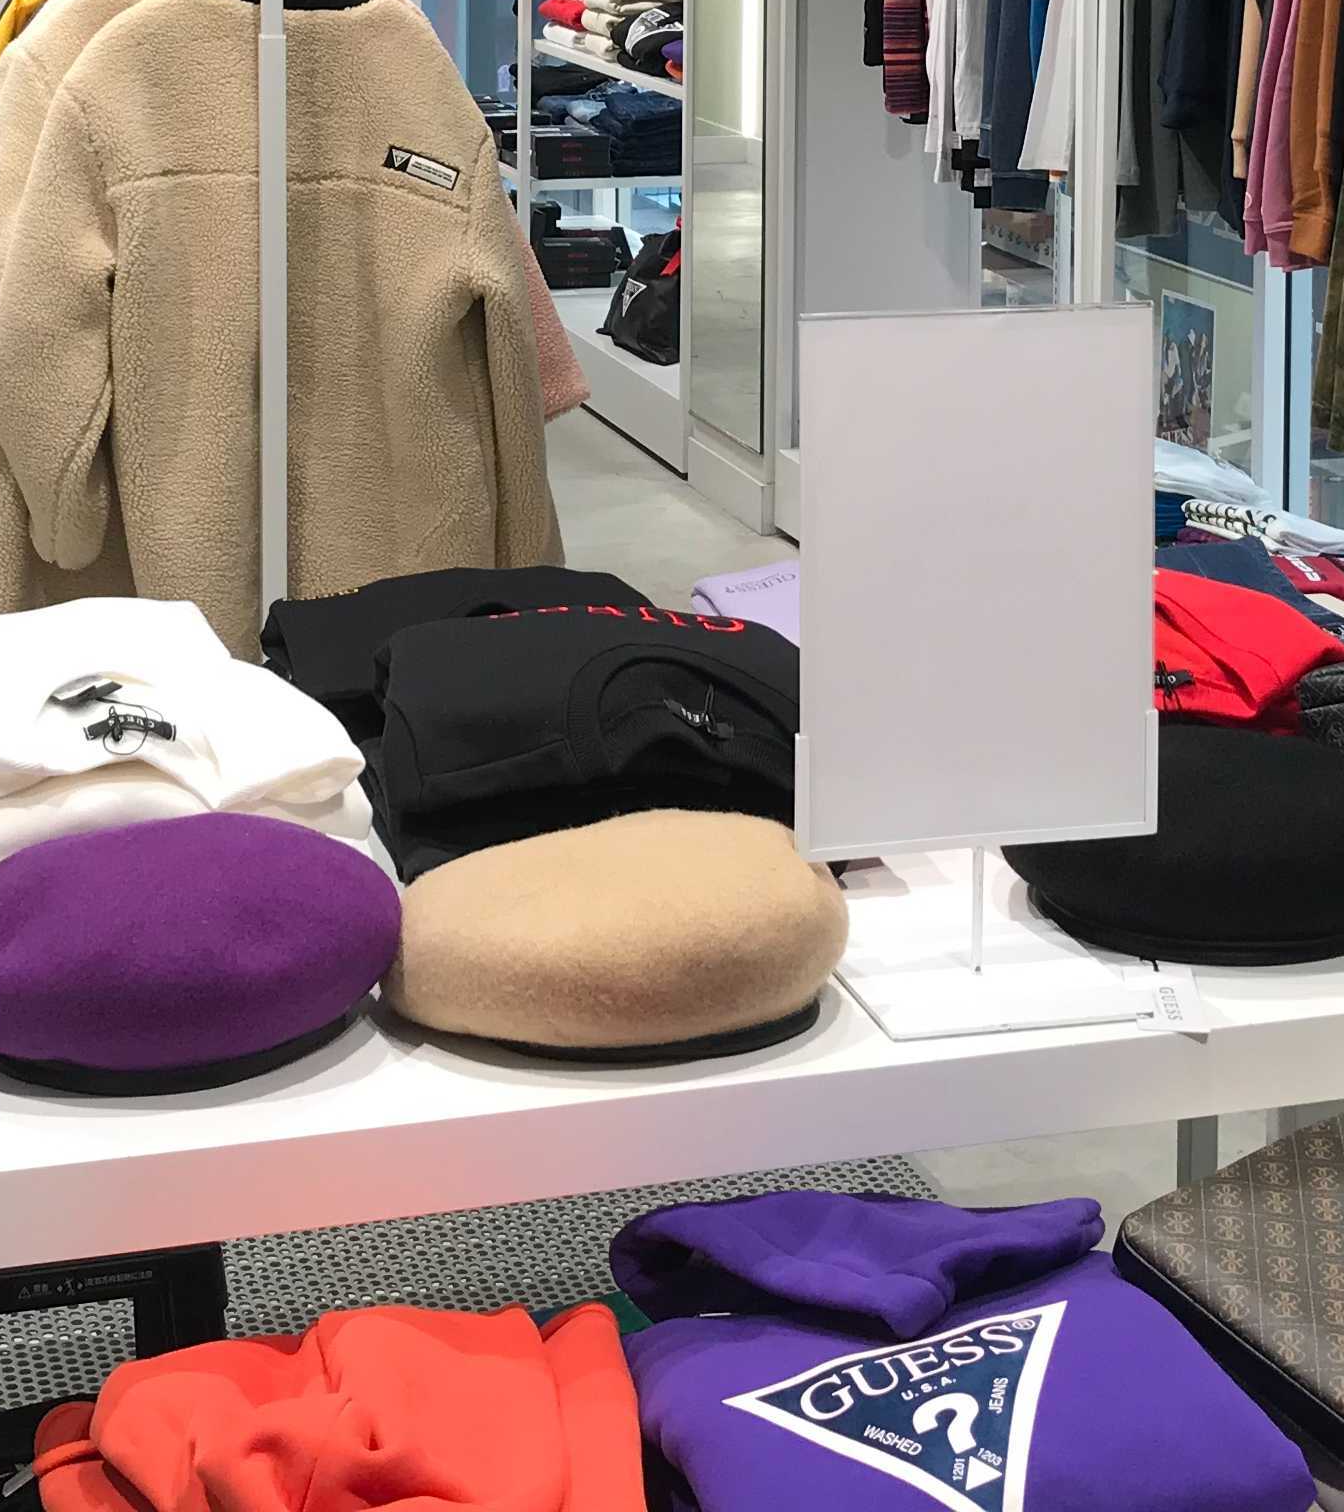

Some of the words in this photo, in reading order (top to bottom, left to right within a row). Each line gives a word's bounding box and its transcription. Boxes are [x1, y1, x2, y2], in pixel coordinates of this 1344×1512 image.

[988, 1377, 1009, 1415] JEANS
[862, 1424, 923, 1457] WASHED
[952, 1457, 966, 1482] 1201
[977, 1447, 1003, 1467] 1203
